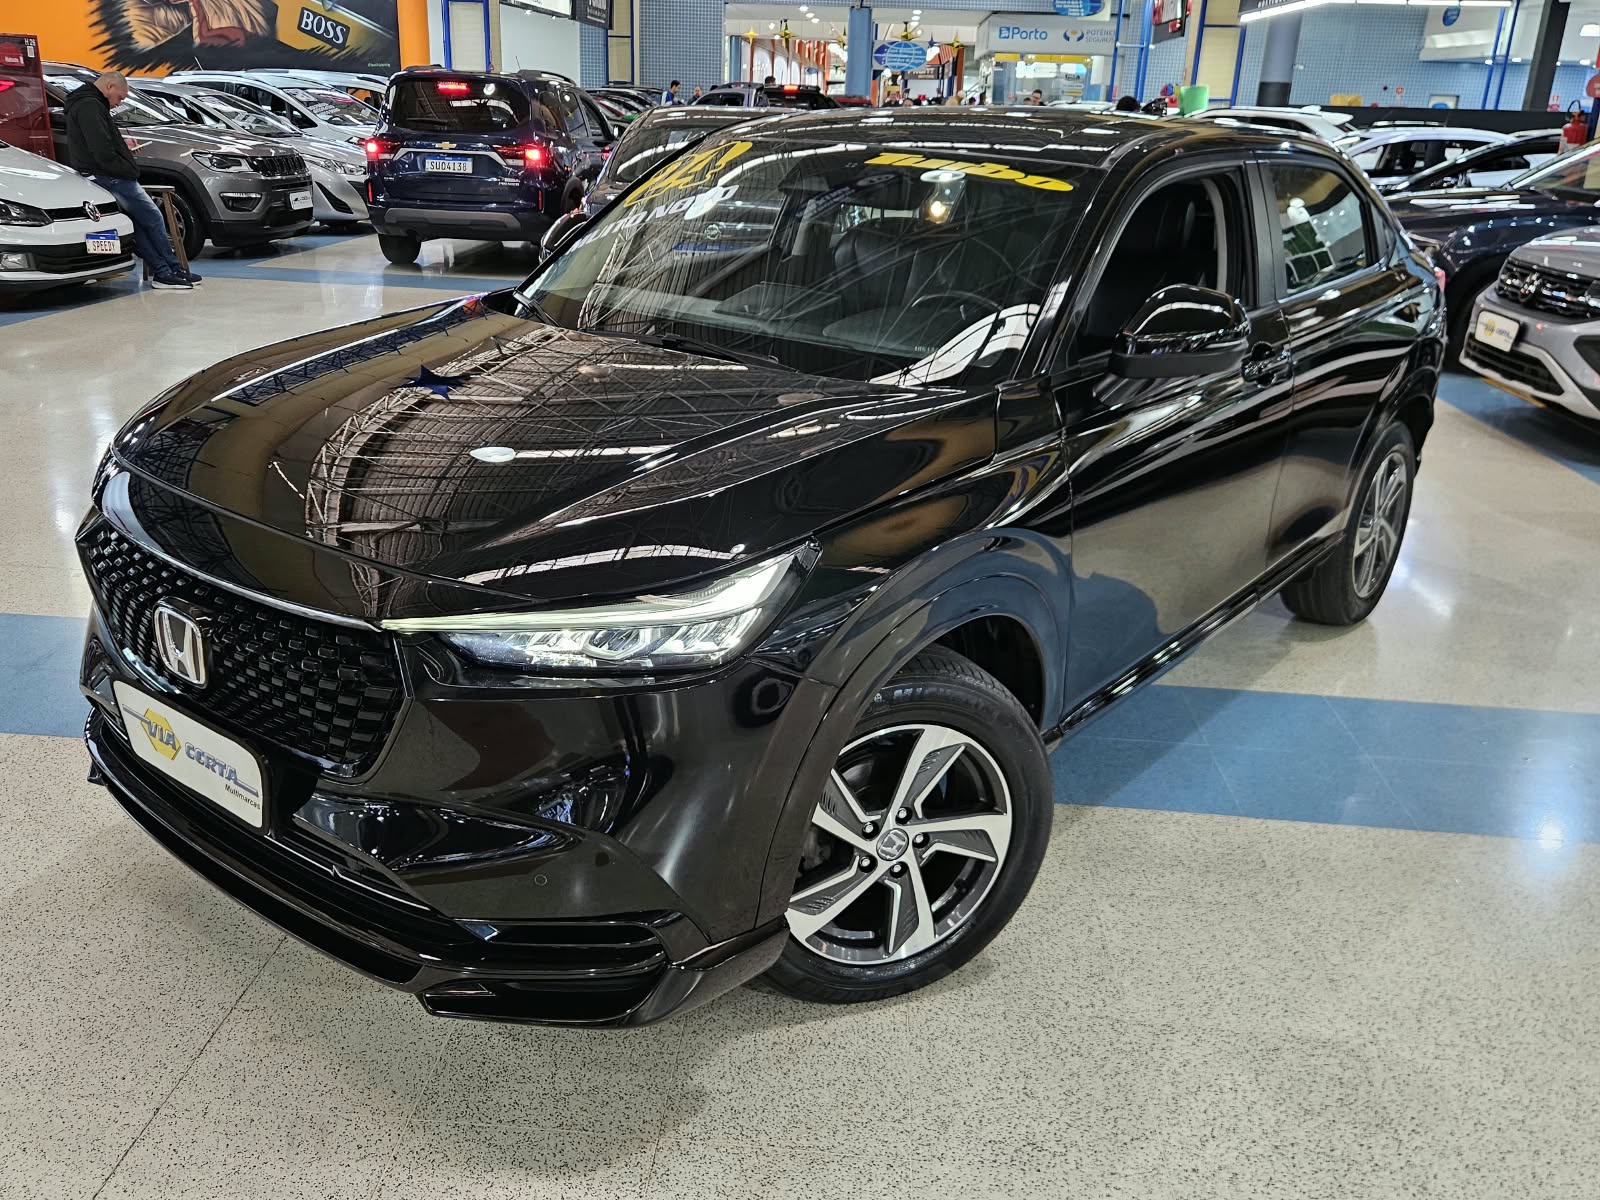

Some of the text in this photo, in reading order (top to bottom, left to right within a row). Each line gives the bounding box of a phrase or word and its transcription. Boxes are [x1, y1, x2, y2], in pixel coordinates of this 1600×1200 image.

[301, 9, 346, 44] BOSS
[1012, 26, 1048, 40] Porto
[864, 152, 1074, 192] Turbo
[92, 240, 115, 252] SPEEDY
[147, 720, 178, 751] VIA
[225, 783, 261, 811] Multimarcas
